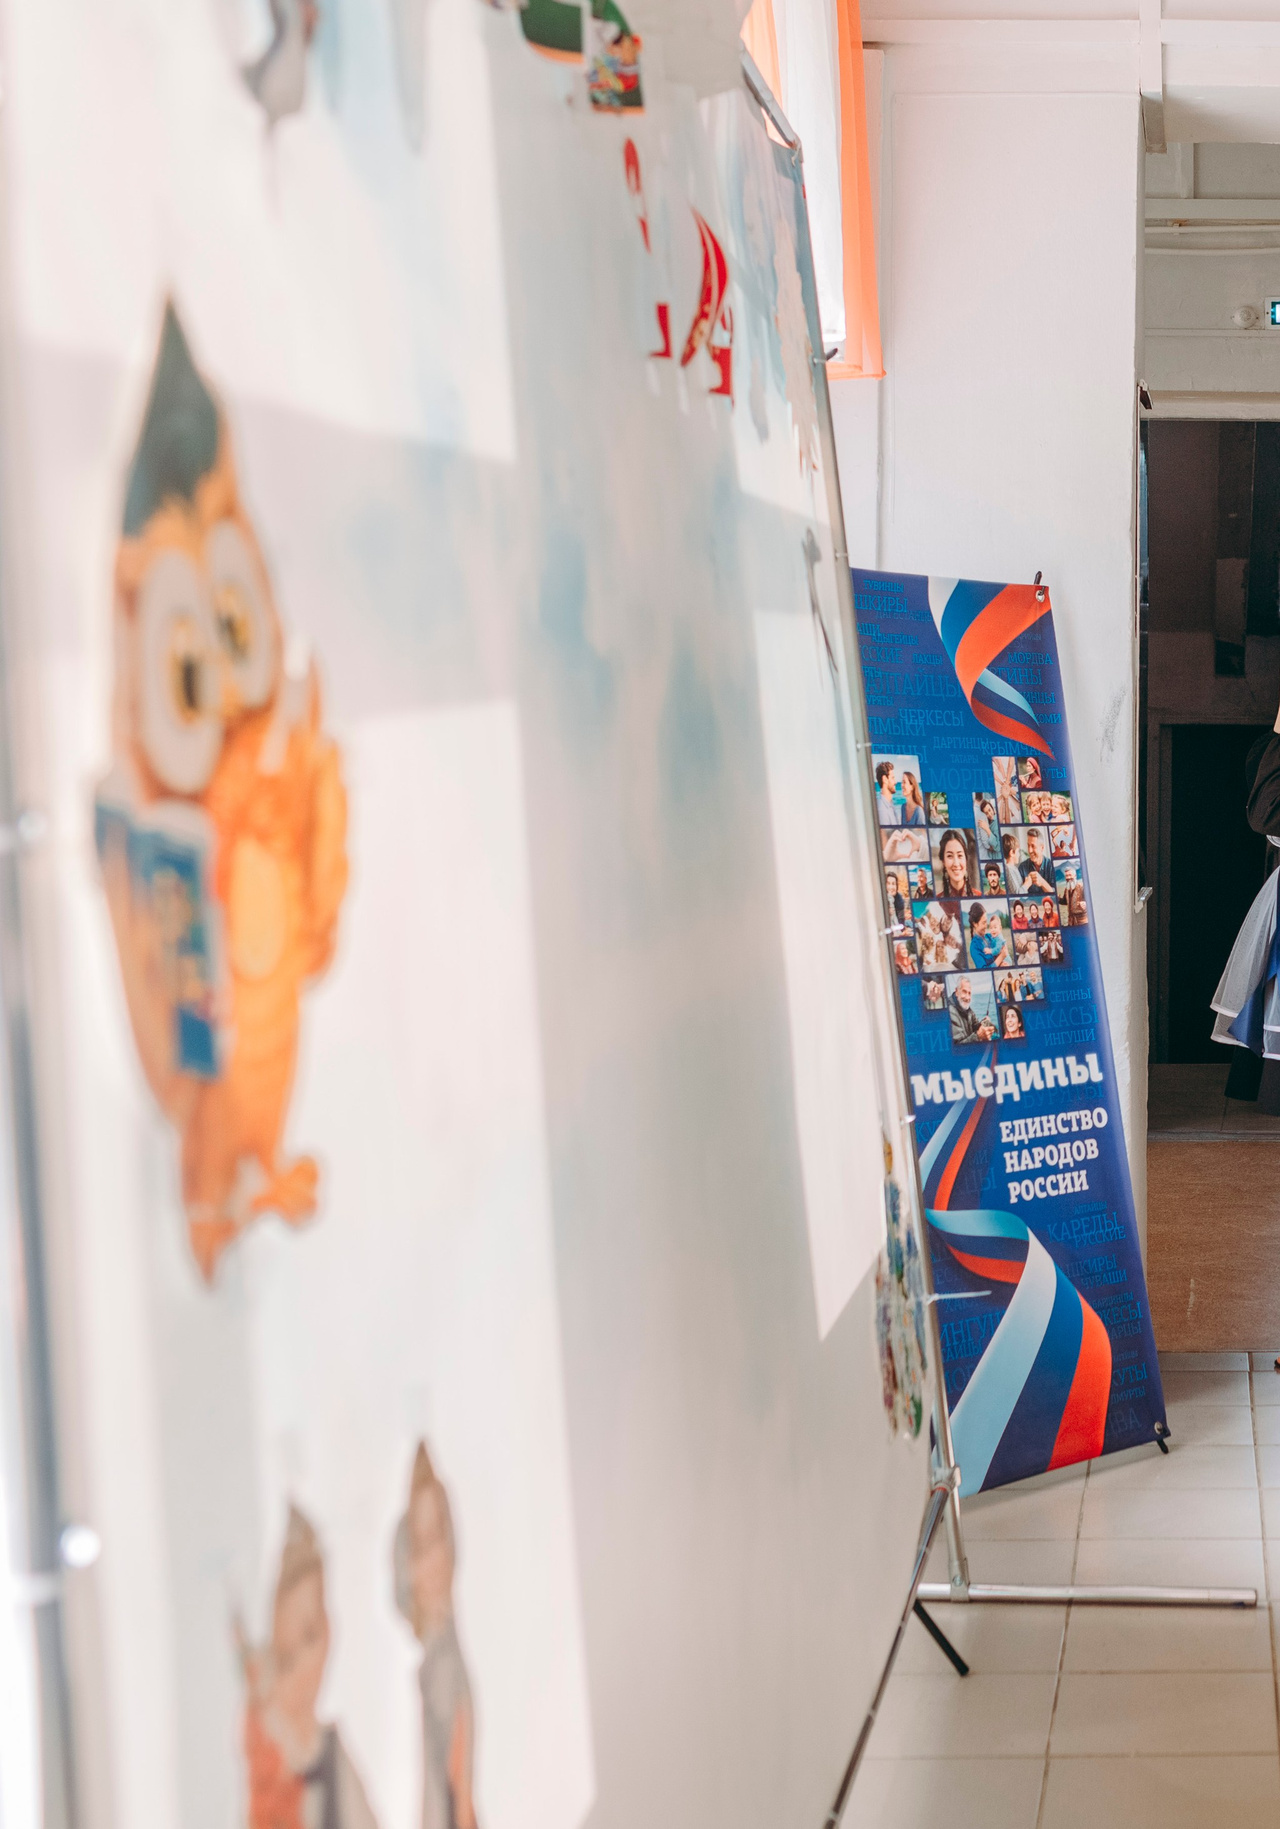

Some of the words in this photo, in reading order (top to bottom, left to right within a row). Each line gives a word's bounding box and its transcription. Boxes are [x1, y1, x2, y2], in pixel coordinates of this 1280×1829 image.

[863, 580, 904, 594] ТУВИНЦЫ
[912, 653, 943, 666] ЛАКЦЫ
[1008, 651, 1054, 666] МОРДВА
[865, 667, 963, 701] АЛТАЙЦЫ
[899, 708, 965, 727] ЧЕРКЕСЫ
[950, 753, 979, 764] ТАТАРЫ
[1044, 1028, 1096, 1047] ИНГУШИ
[999, 1106, 1109, 1147] ЕДИНСТВО
[1003, 1138, 1100, 1174] НАРОДОВ
[1007, 1169, 1090, 1205] РОССИИ
[1047, 1211, 1119, 1244] КАРЕЛЫ
[1074, 1225, 1127, 1249] РУССКИЕ
[1081, 1269, 1128, 1290] ЧУВАШИ
